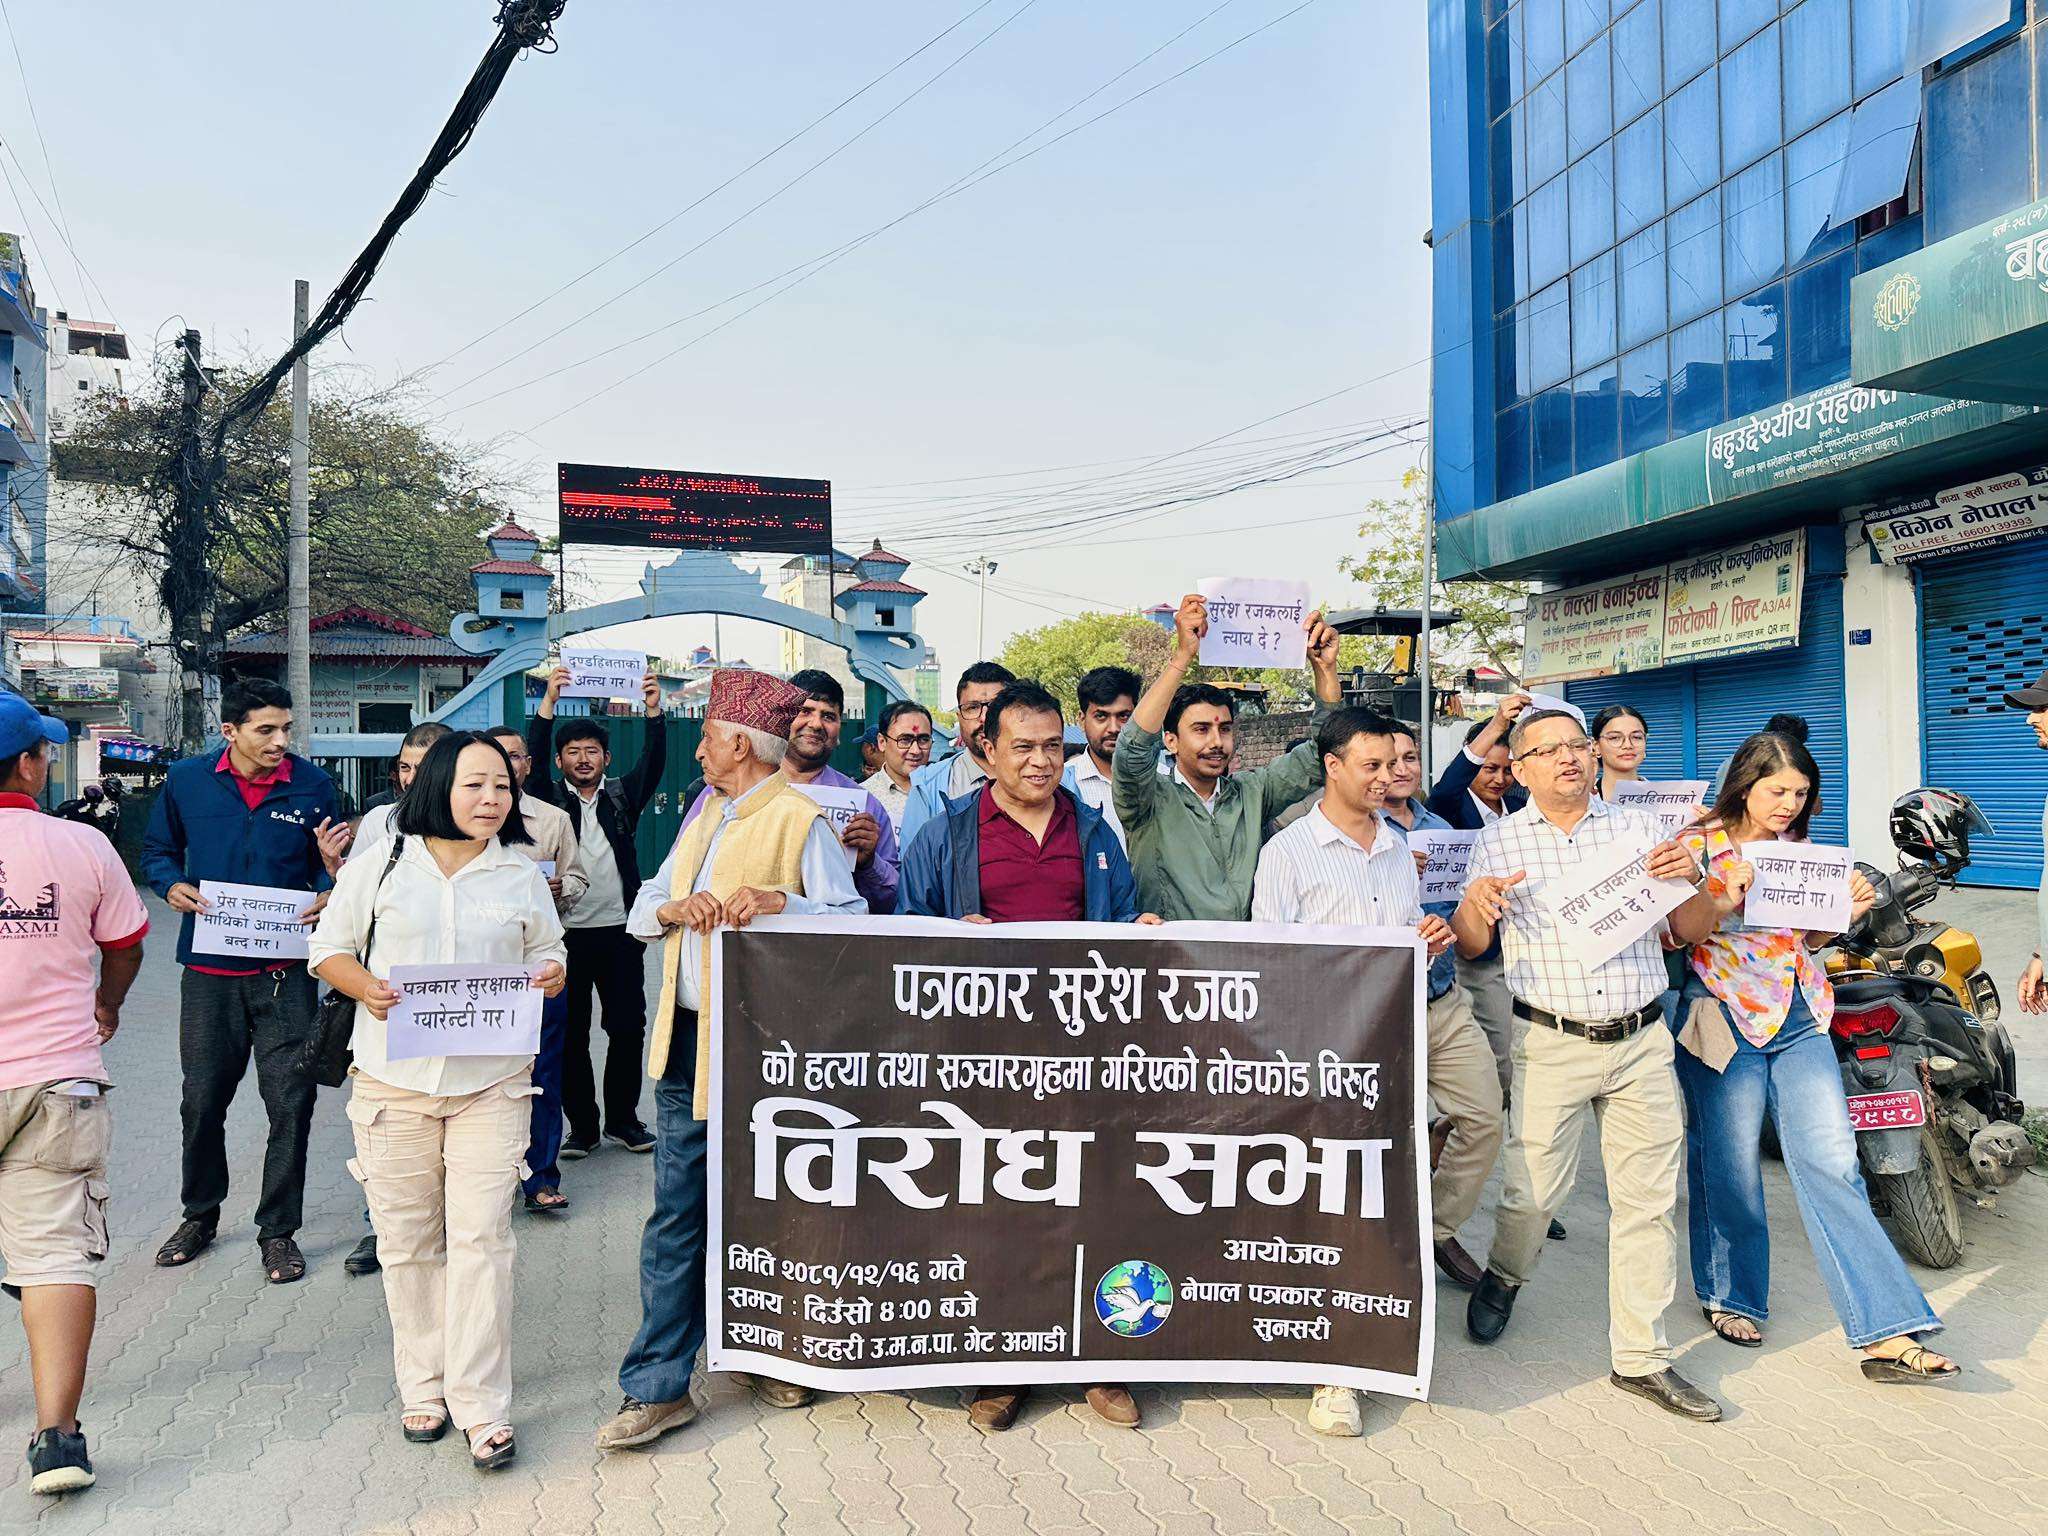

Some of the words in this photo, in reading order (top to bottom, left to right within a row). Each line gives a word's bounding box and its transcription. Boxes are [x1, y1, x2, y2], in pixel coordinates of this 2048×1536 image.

[1958, 494, 2036, 524] नेपाल
[1891, 541, 1921, 552] TOLL
[1920, 534, 1950, 548] FREE
[1896, 554, 1917, 565] Surya
[1917, 550, 1937, 560] Kiran
[1937, 546, 1950, 556] Life
[1950, 543, 1969, 553] Care
[1209, 596, 1240, 623] सुरेश
[1245, 600, 1302, 624] रजकलाई
[1541, 598, 1560, 622] घर
[1667, 600, 1719, 637] फोटोकपी
[1761, 597, 1791, 615] A3/A4
[1222, 631, 1253, 646] न्याय
[1258, 626, 1268, 650] दे
[568, 654, 640, 670] दण्डहिनताको
[610, 676, 627, 688] गर
[1618, 790, 1696, 805] दण्डहिनताको
[270, 811, 306, 825] EAGLE
[1659, 814, 1676, 826] गर
[1427, 838, 1446, 857] प्रेस
[1755, 857, 1797, 876] पत्रकार
[1800, 858, 1847, 883] सुरक्षाको
[1446, 880, 1460, 892] गर
[1762, 882, 1806, 906] ग्यारेन्टी
[1810, 891, 1826, 909] गर
[217, 891, 238, 909] प्रेस
[242, 897, 297, 914] स्वतन्त्रता
[1558, 894, 1591, 925] सुरेश
[1588, 908, 1628, 936] न्याय
[1622, 895, 1644, 913] दे
[204, 911, 249, 929] माथिको
[254, 919, 305, 934] आक्रमण
[224, 935, 249, 950] बन्द
[254, 940, 271, 950] गर
[403, 978, 461, 996] पत्रकार
[466, 971, 534, 1000] सुरक्षाको
[893, 964, 1037, 1022] पत्रकार
[1049, 950, 1146, 1037] सुरेश
[1158, 968, 1260, 1025] रजक
[413, 1001, 477, 1030] ग्यारेन्टी
[482, 1009, 505, 1029] गर
[761, 1040, 797, 1087] को
[803, 1052, 870, 1093] हत्या
[877, 1053, 929, 1089] तथा
[936, 1054, 1094, 1101] सञ्चारगृहमा
[1101, 1043, 1199, 1094] गरिएको
[1207, 1047, 1311, 1098] तोडफोड
[748, 1096, 1096, 1211] विरोध
[1133, 1131, 1393, 1219] सभा
[1223, 1236, 1343, 1267] आयोजक
[728, 1243, 777, 1276] मिति
[781, 1259, 921, 1290] २०८१/१२/१६
[928, 1254, 968, 1281] गते
[727, 1286, 784, 1315] समय
[803, 1293, 873, 1326] दिउँसो
[939, 1290, 979, 1318] बजे
[1180, 1276, 1242, 1304] नेपाल
[1247, 1283, 1327, 1309] पत्रकार
[1330, 1288, 1412, 1319] महासंघ
[727, 1321, 785, 1351] स्थान
[801, 1332, 865, 1361] इटहरी
[964, 1325, 996, 1353] गेट
[1001, 1325, 1067, 1354] अगाडी
[1253, 1316, 1332, 1342] सुनसरी
